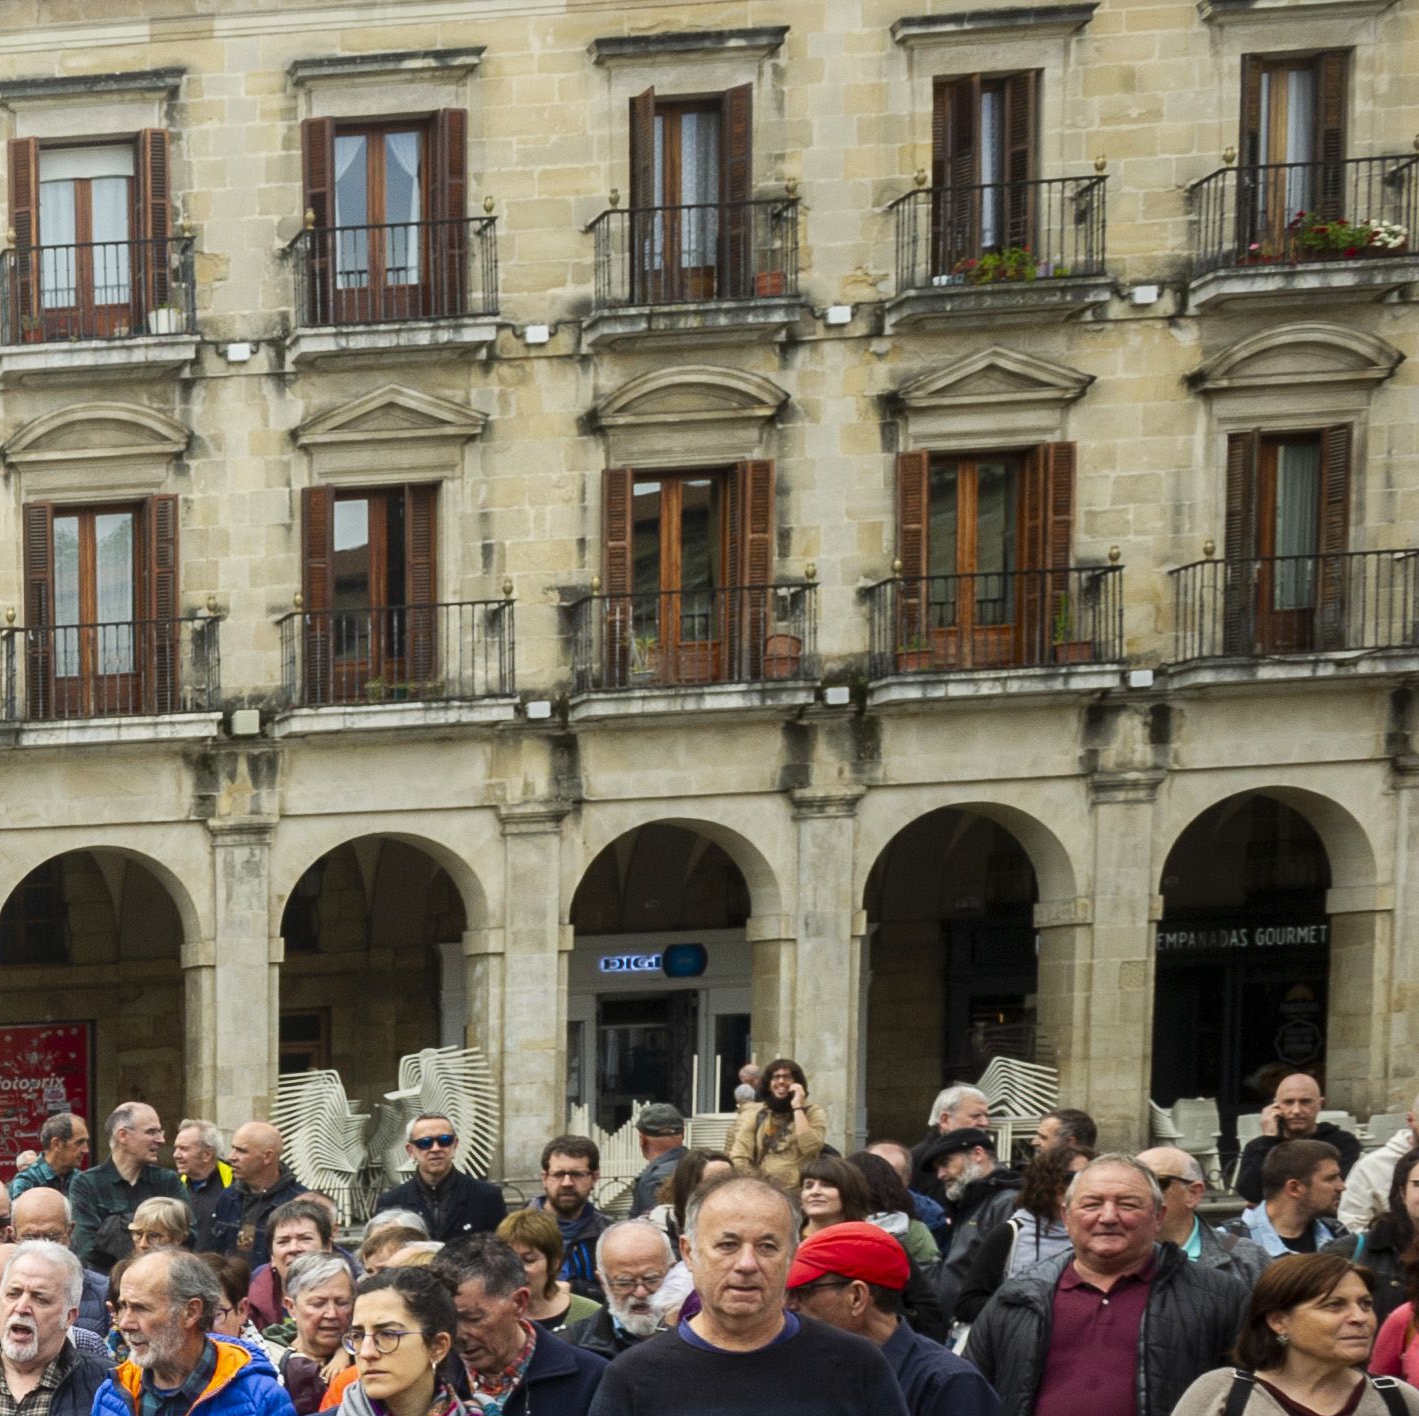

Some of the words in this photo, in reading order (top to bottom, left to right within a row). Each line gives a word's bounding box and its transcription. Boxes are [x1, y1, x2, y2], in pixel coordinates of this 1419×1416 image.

[1157, 928, 1248, 950] EMPANADAS
[1255, 924, 1328, 946] GOURMET
[600, 954, 662, 972] DIGI
